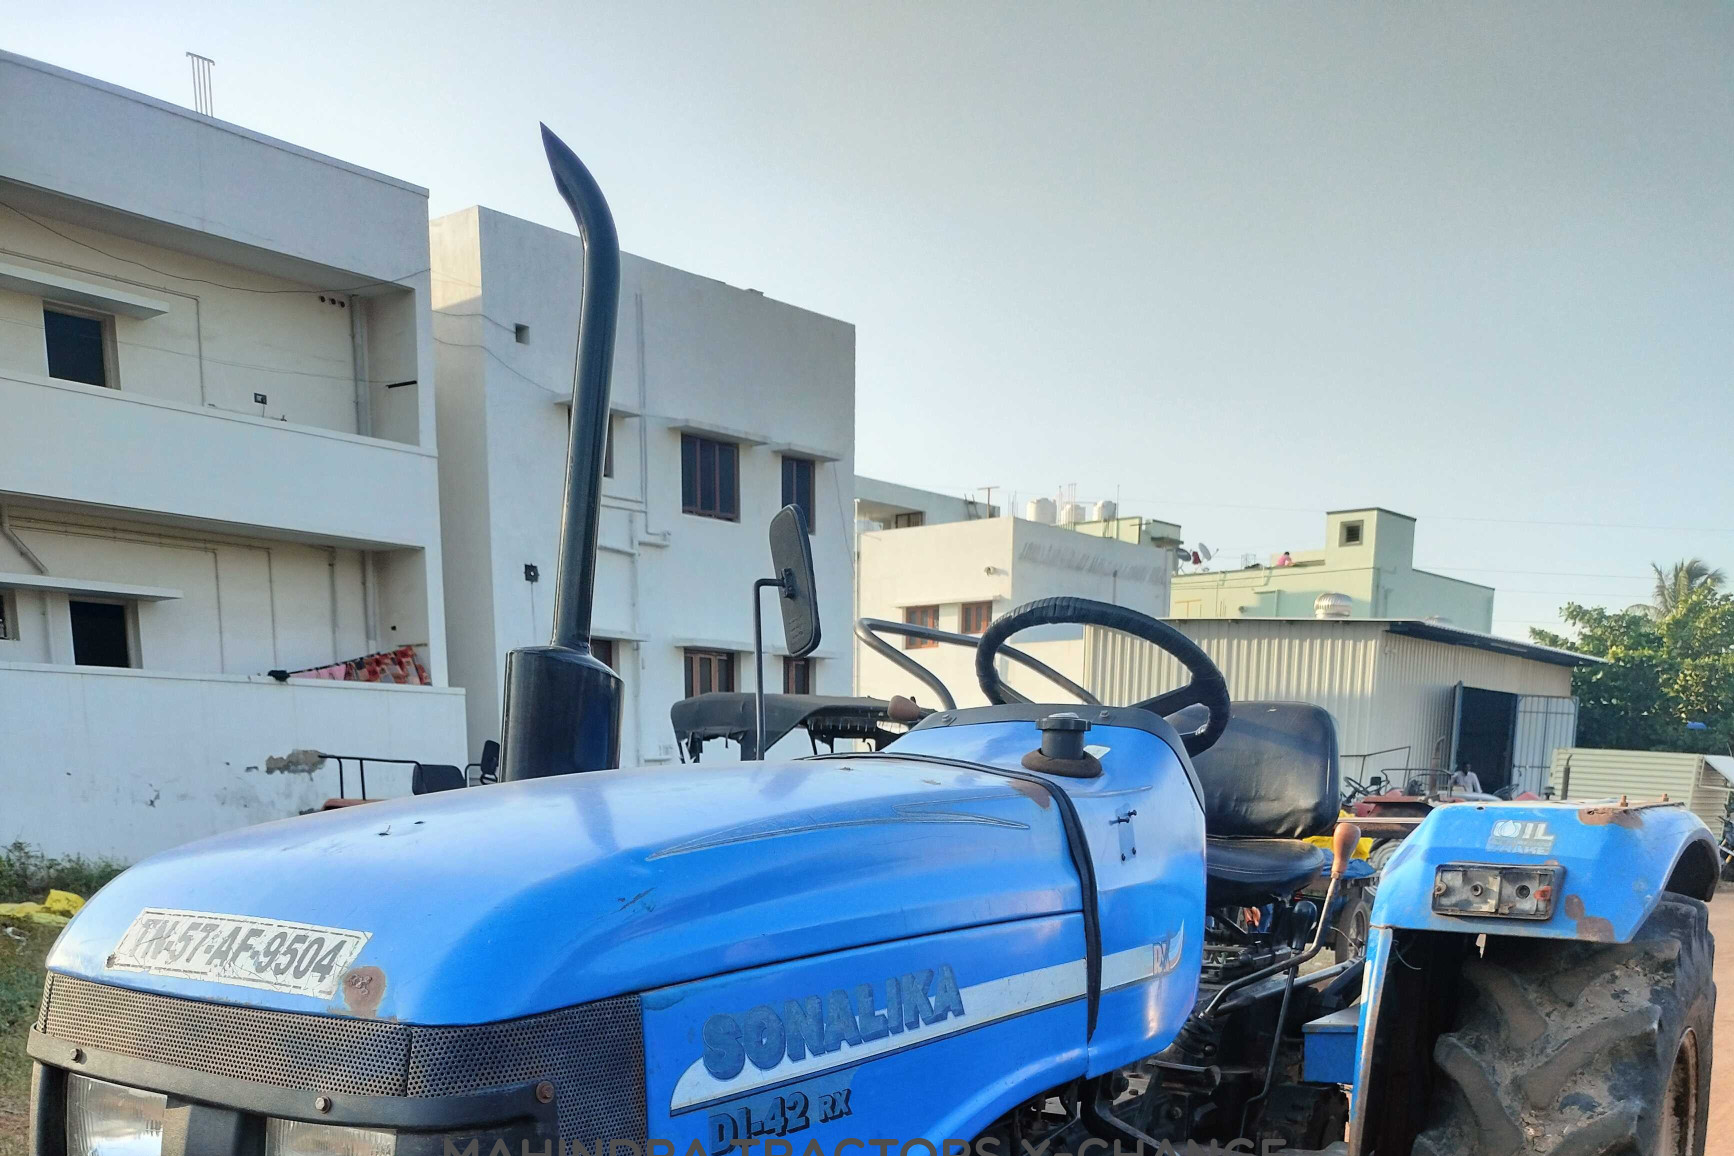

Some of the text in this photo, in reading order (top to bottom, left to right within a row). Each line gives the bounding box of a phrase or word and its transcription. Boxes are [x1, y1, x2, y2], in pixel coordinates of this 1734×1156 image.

[1492, 819, 1556, 840] OIL
[702, 963, 966, 1082] SONALIKA
[818, 1088, 853, 1124] RX
